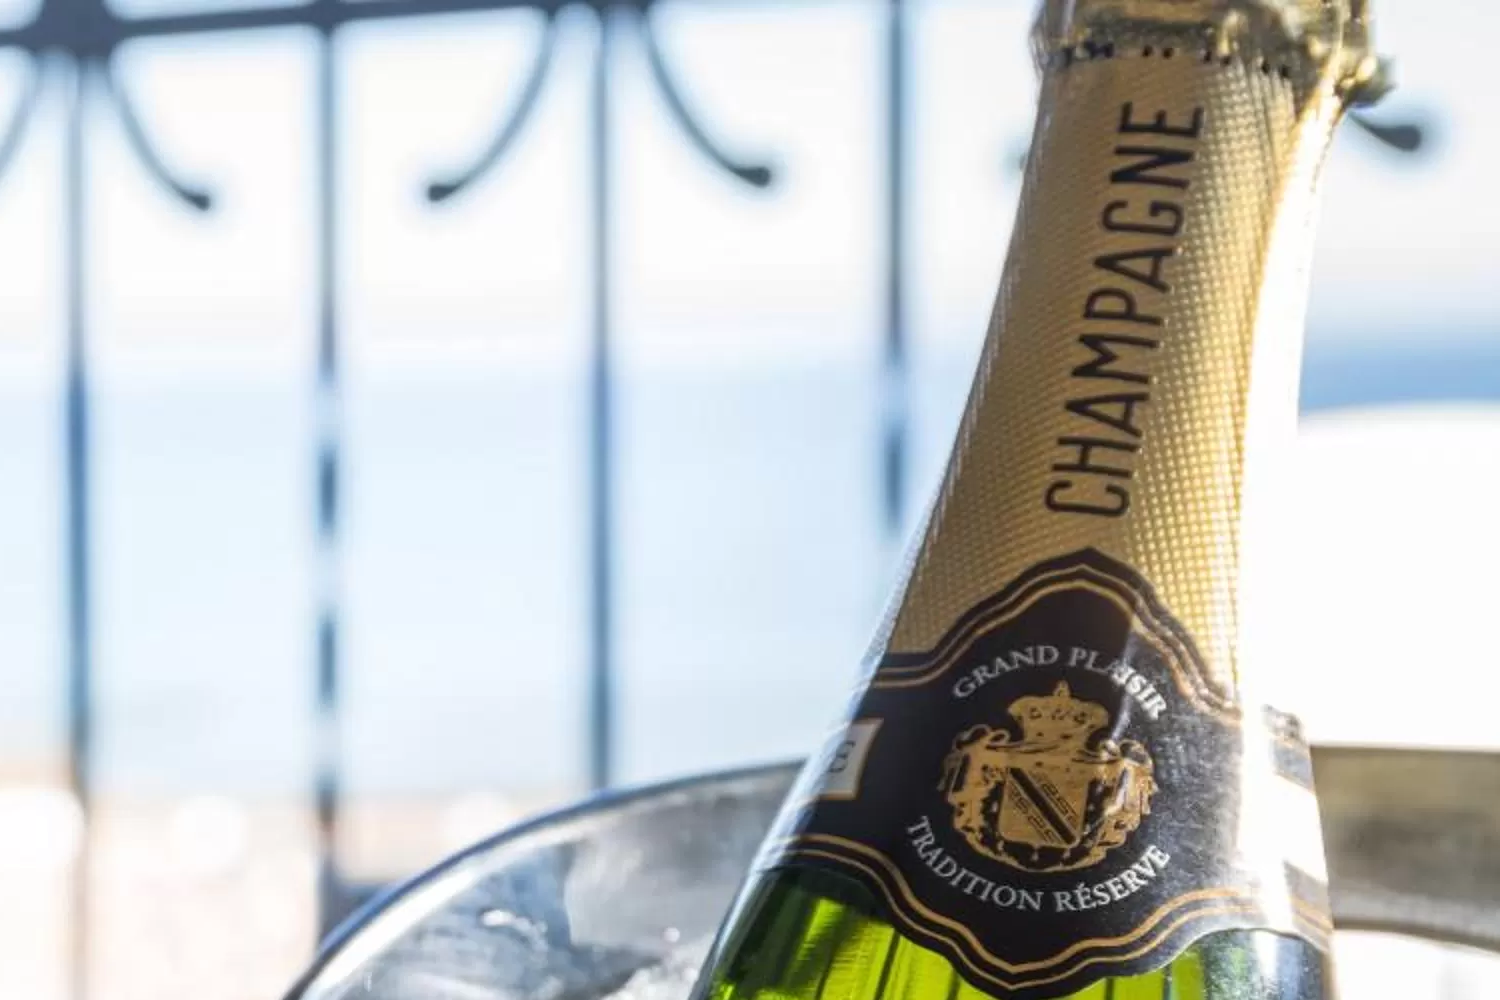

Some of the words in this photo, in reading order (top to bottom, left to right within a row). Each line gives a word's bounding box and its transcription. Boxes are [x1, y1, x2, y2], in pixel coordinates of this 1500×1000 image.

[1044, 101, 1204, 518] CHAMPAGNE
[952, 644, 1059, 701] GRAND
[1068, 646, 1168, 720] PLAISIR
[905, 815, 1043, 912] TRADITION
[1054, 843, 1171, 913] RÉSERVE
